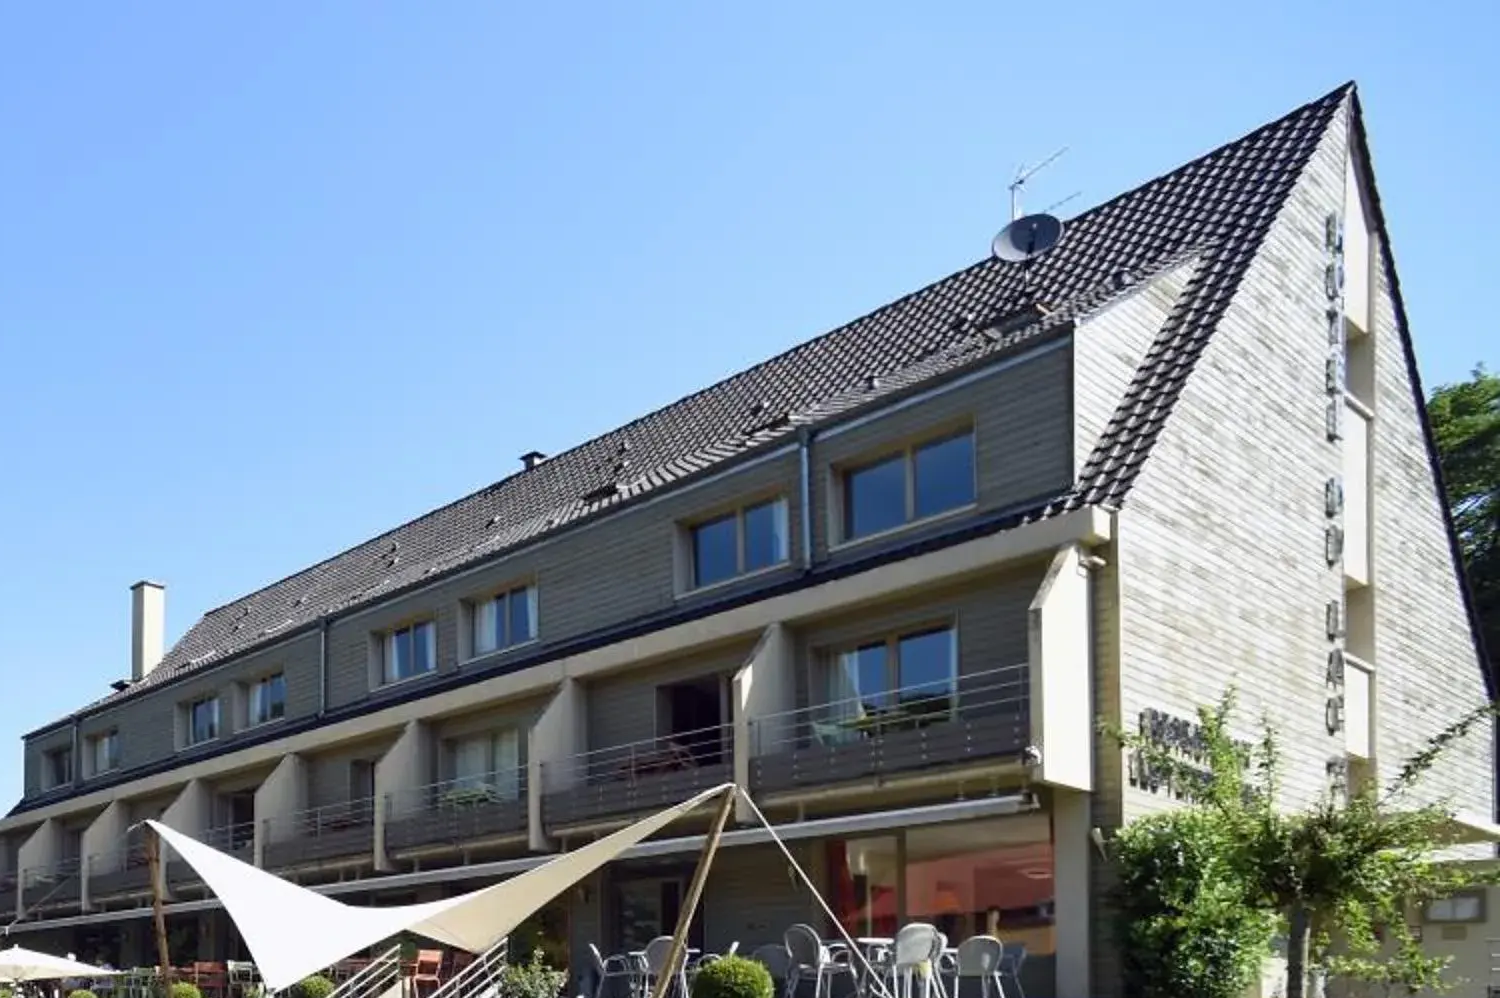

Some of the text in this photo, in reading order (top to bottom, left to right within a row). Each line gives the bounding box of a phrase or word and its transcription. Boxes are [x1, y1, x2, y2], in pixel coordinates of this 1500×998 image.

[1325, 212, 1344, 442] HOTEL
[1325, 478, 1344, 569] DU
[1326, 600, 1346, 734] LAC
